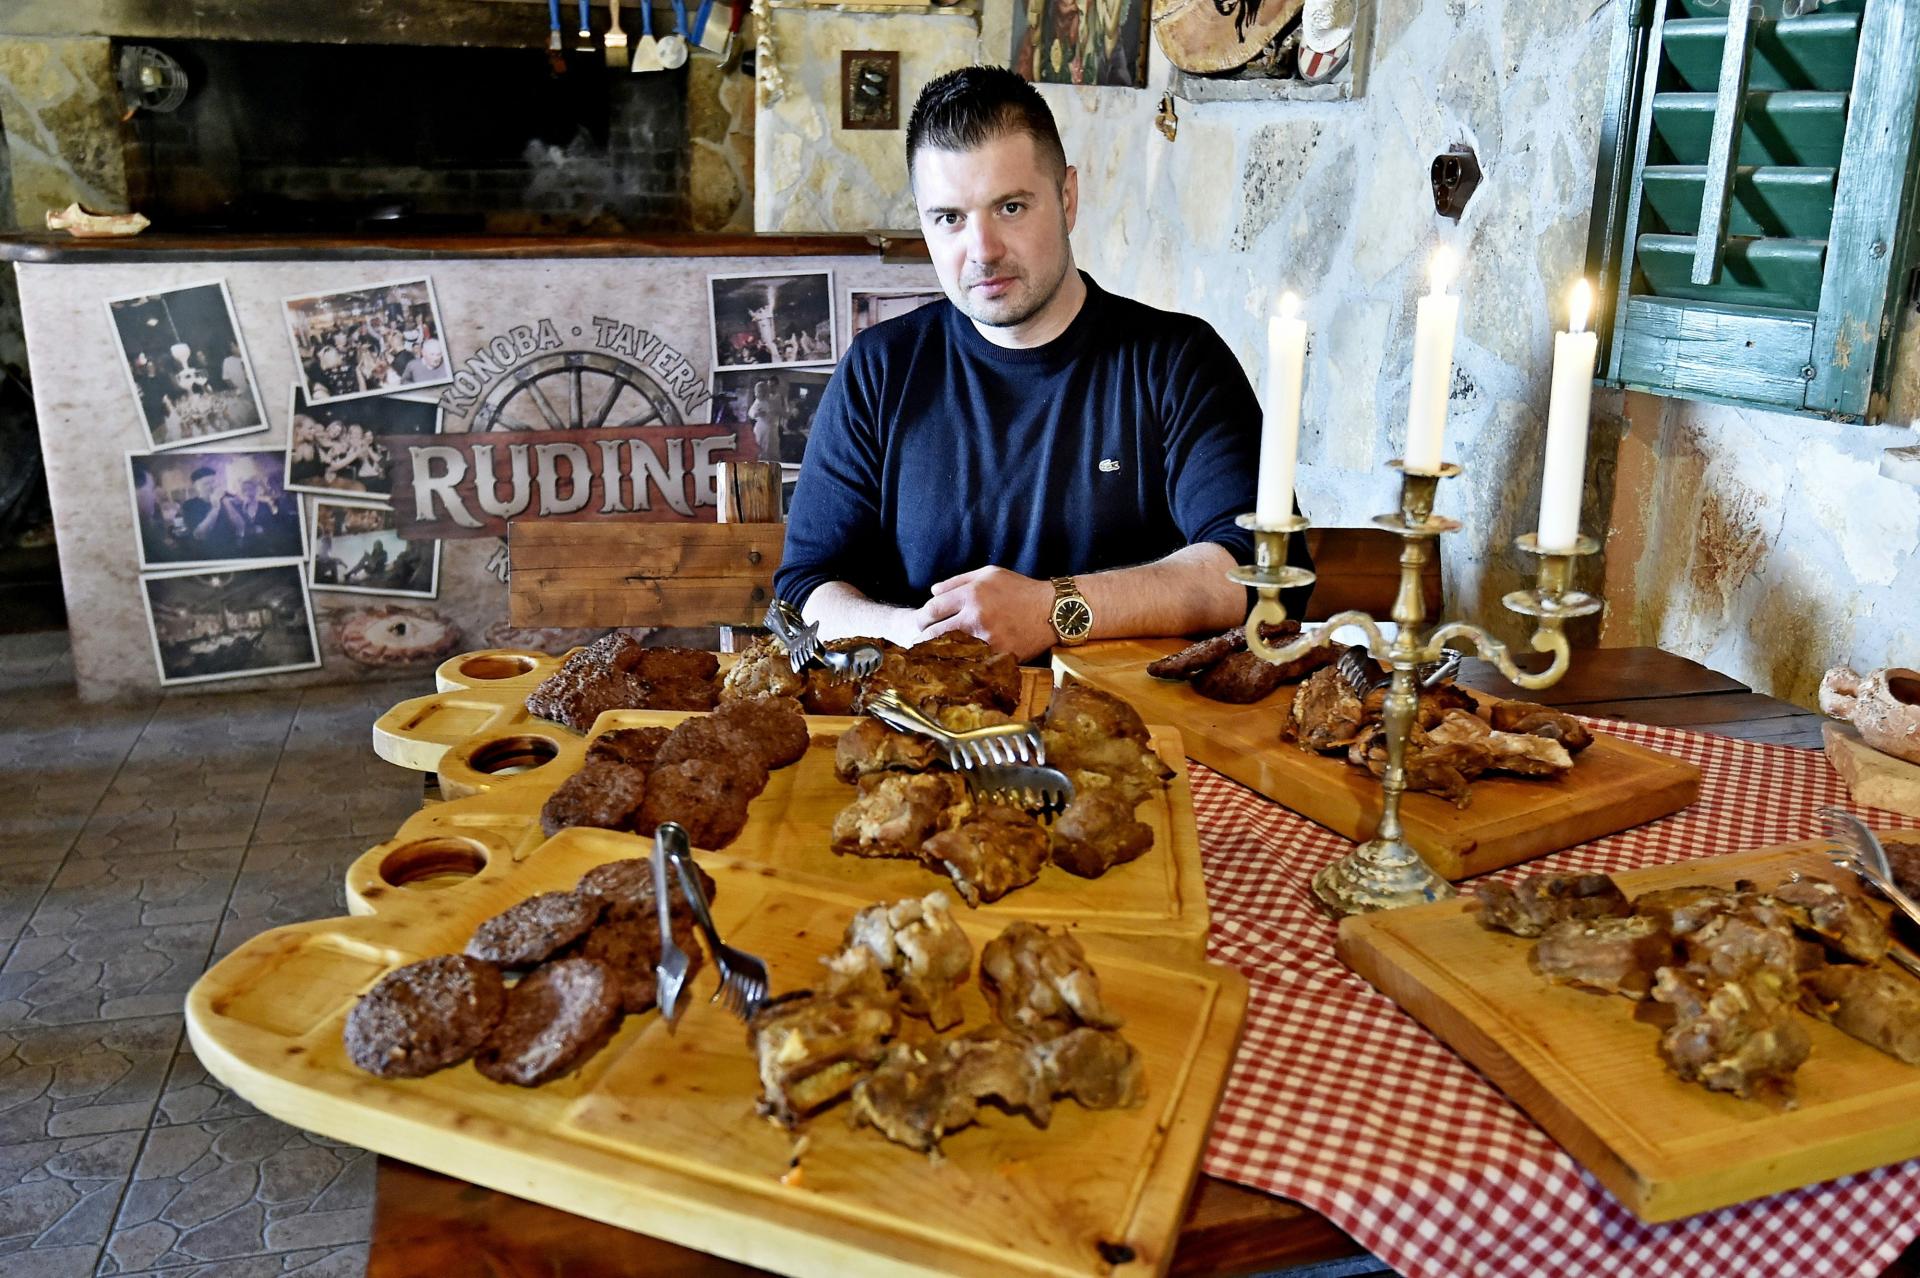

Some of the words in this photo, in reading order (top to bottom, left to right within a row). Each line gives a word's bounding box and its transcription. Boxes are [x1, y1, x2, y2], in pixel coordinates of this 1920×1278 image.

[439, 319, 563, 418] KONOBA
[593, 316, 712, 415] TAVERN
[408, 433, 737, 529] RUDINE
